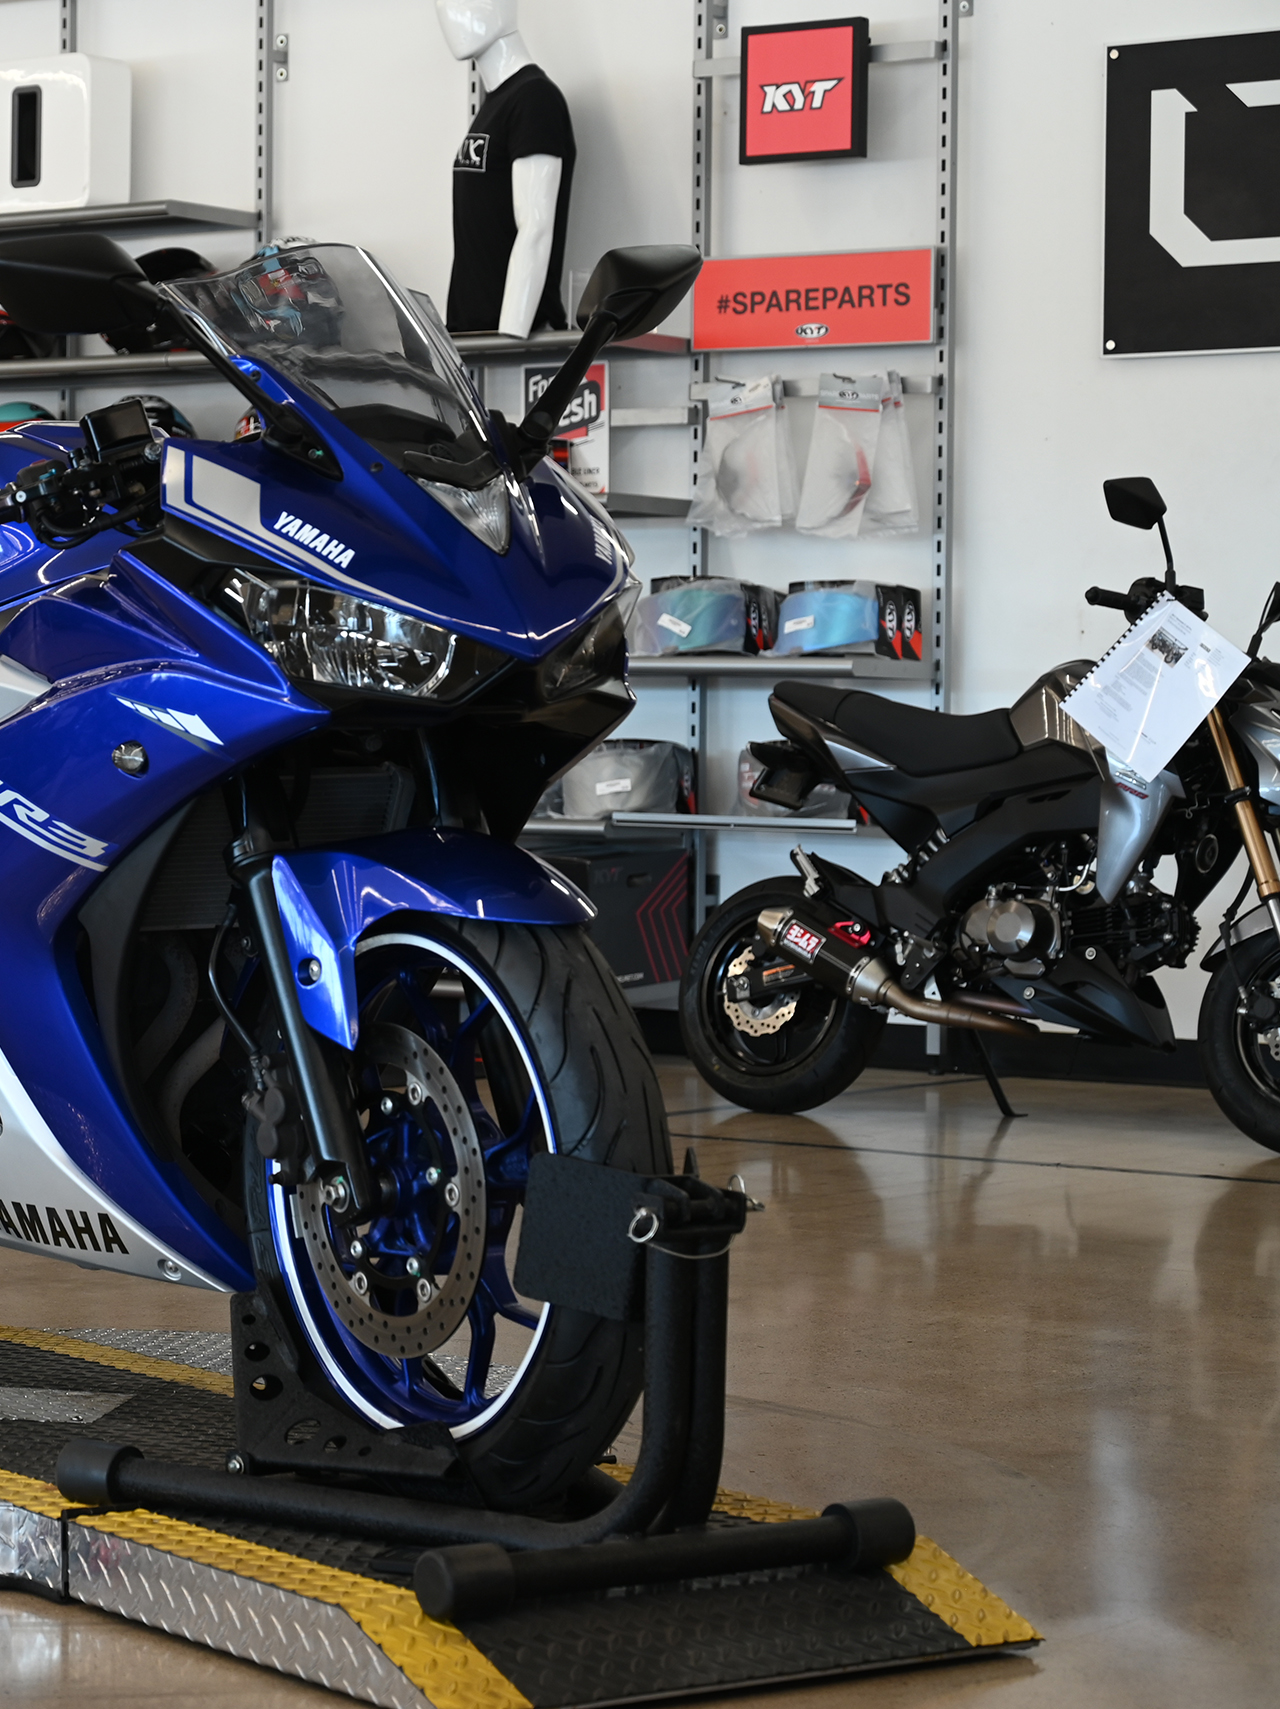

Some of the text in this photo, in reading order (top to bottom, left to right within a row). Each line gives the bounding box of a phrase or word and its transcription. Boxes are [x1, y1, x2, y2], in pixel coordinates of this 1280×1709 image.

[759, 77, 844, 114] KYT
[717, 283, 911, 315] #SPAREPARTS
[273, 511, 356, 569] YAMAHA
